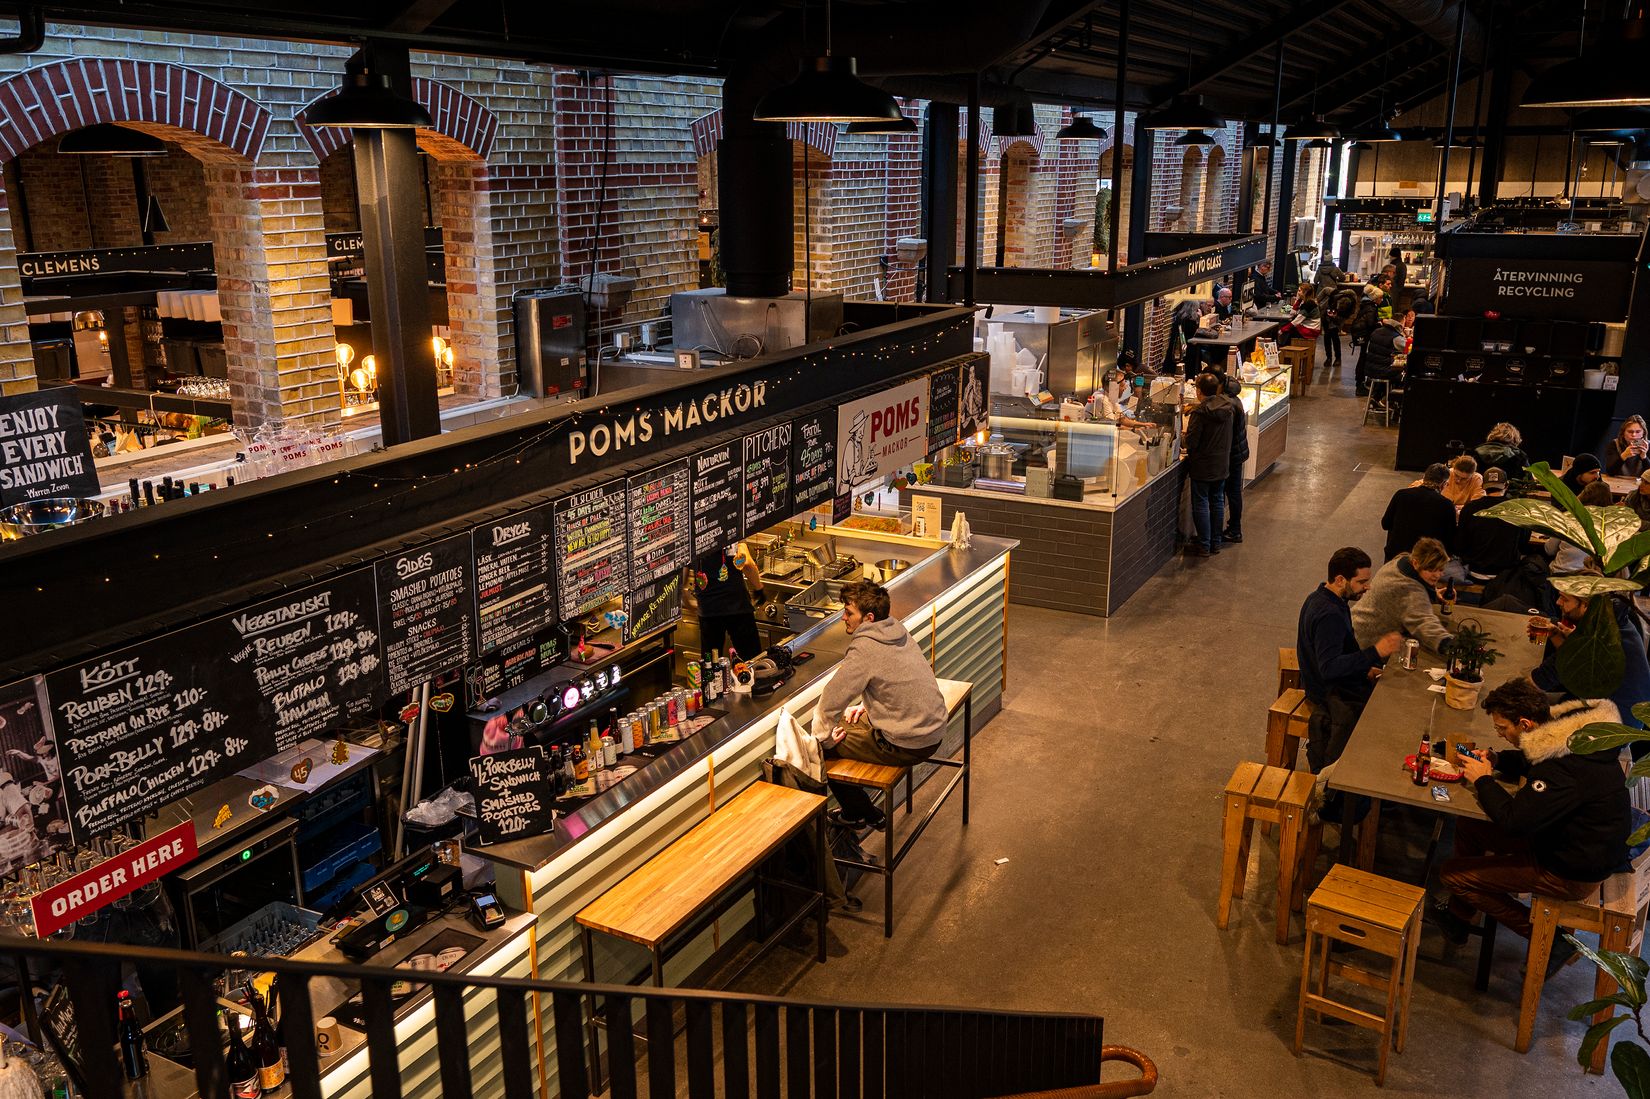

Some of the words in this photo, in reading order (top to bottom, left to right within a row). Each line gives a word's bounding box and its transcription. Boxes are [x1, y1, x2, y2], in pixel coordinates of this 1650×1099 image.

[22, 258, 100, 276] CLEMENS
[1207, 255, 1222, 271] GLASS
[1493, 267, 1583, 282] ÅTERVINNING
[1498, 286, 1574, 297] RECYCLING
[0, 405, 59, 437] ENJOY
[569, 408, 653, 464] POMS
[664, 380, 765, 435] MACKOR
[871, 396, 919, 443] POMS
[1, 431, 67, 464] EVERY
[283, 450, 307, 461] POMS
[320, 441, 343, 452] POMS
[883, 437, 908, 456] MACKOR
[697, 447, 730, 472] NATURVIN
[50, 483, 70, 493] Zevon
[492, 521, 531, 545] DRYCK
[396, 552, 432, 576] SIDES
[479, 570, 497, 583] GINGER
[499, 565, 510, 575] BEER
[390, 579, 426, 603] SMASHED
[430, 566, 463, 588] POTATOES
[480, 584, 502, 599] JULMUST
[232, 591, 331, 635] VEGETARISKT
[392, 599, 410, 611] CLASSIC
[253, 621, 311, 657] REUBEN
[408, 618, 437, 636] SNACKS
[80, 657, 139, 689] KÖTT
[253, 663, 290, 686] PHILLY
[292, 645, 329, 670] CHEESE
[58, 682, 133, 724] REUBEN
[272, 675, 325, 713] BUFFALO
[64, 721, 128, 754] PASTRAMI
[129, 715, 145, 729] ON
[146, 703, 170, 723] RYE
[490, 771, 541, 791] SANDWICH
[481, 792, 535, 812] SMASHED
[481, 800, 541, 823] POTATOES
[51, 867, 127, 917] ORDER
[132, 838, 184, 878] HERE
